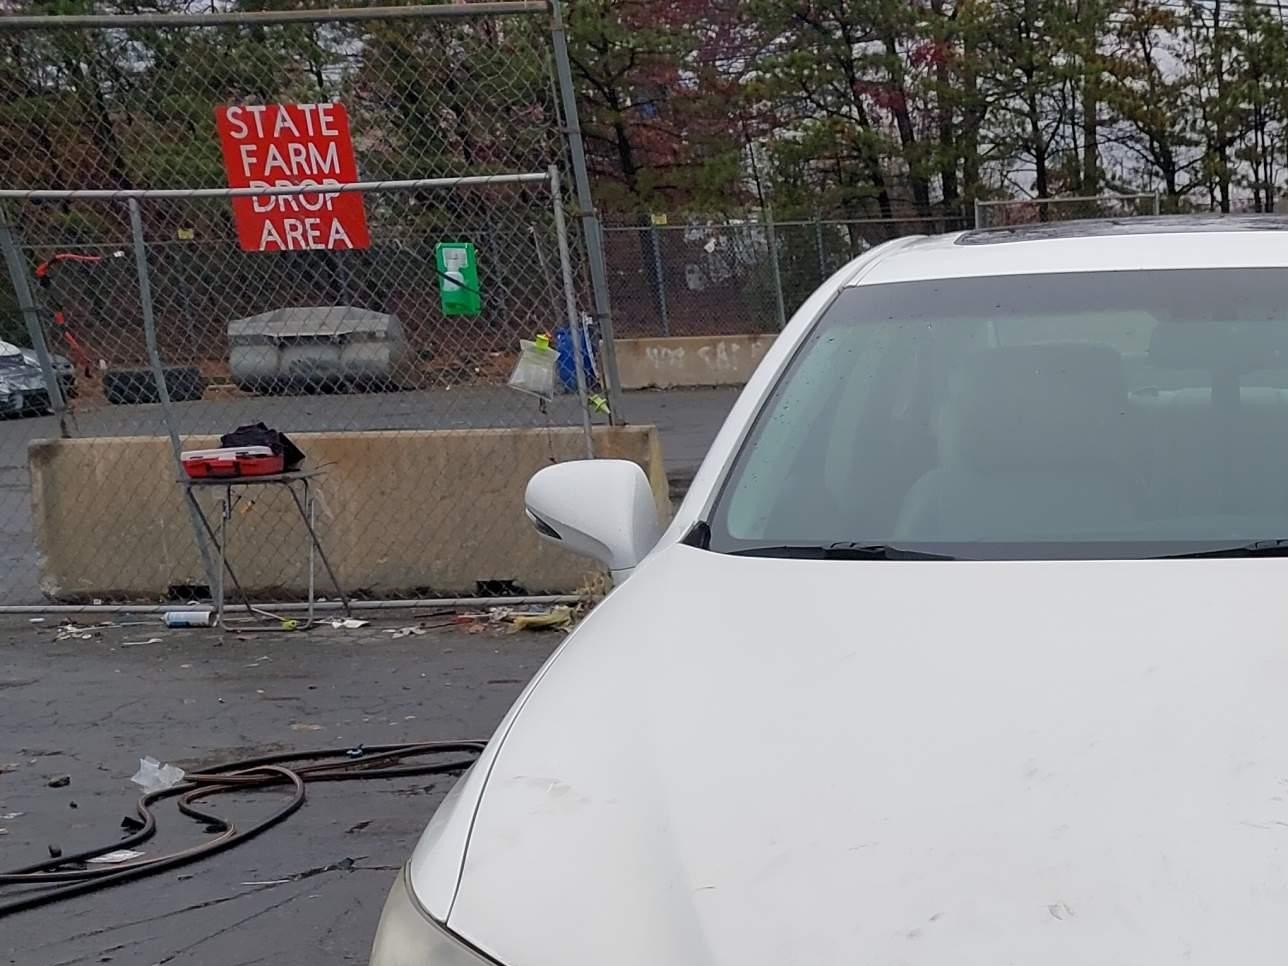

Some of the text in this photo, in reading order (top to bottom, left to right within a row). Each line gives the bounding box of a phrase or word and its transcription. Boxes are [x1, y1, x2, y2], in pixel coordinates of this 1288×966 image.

[226, 103, 339, 139] STATE
[240, 142, 340, 176] FARM
[250, 179, 340, 213] DROP
[259, 218, 354, 251] AREA
